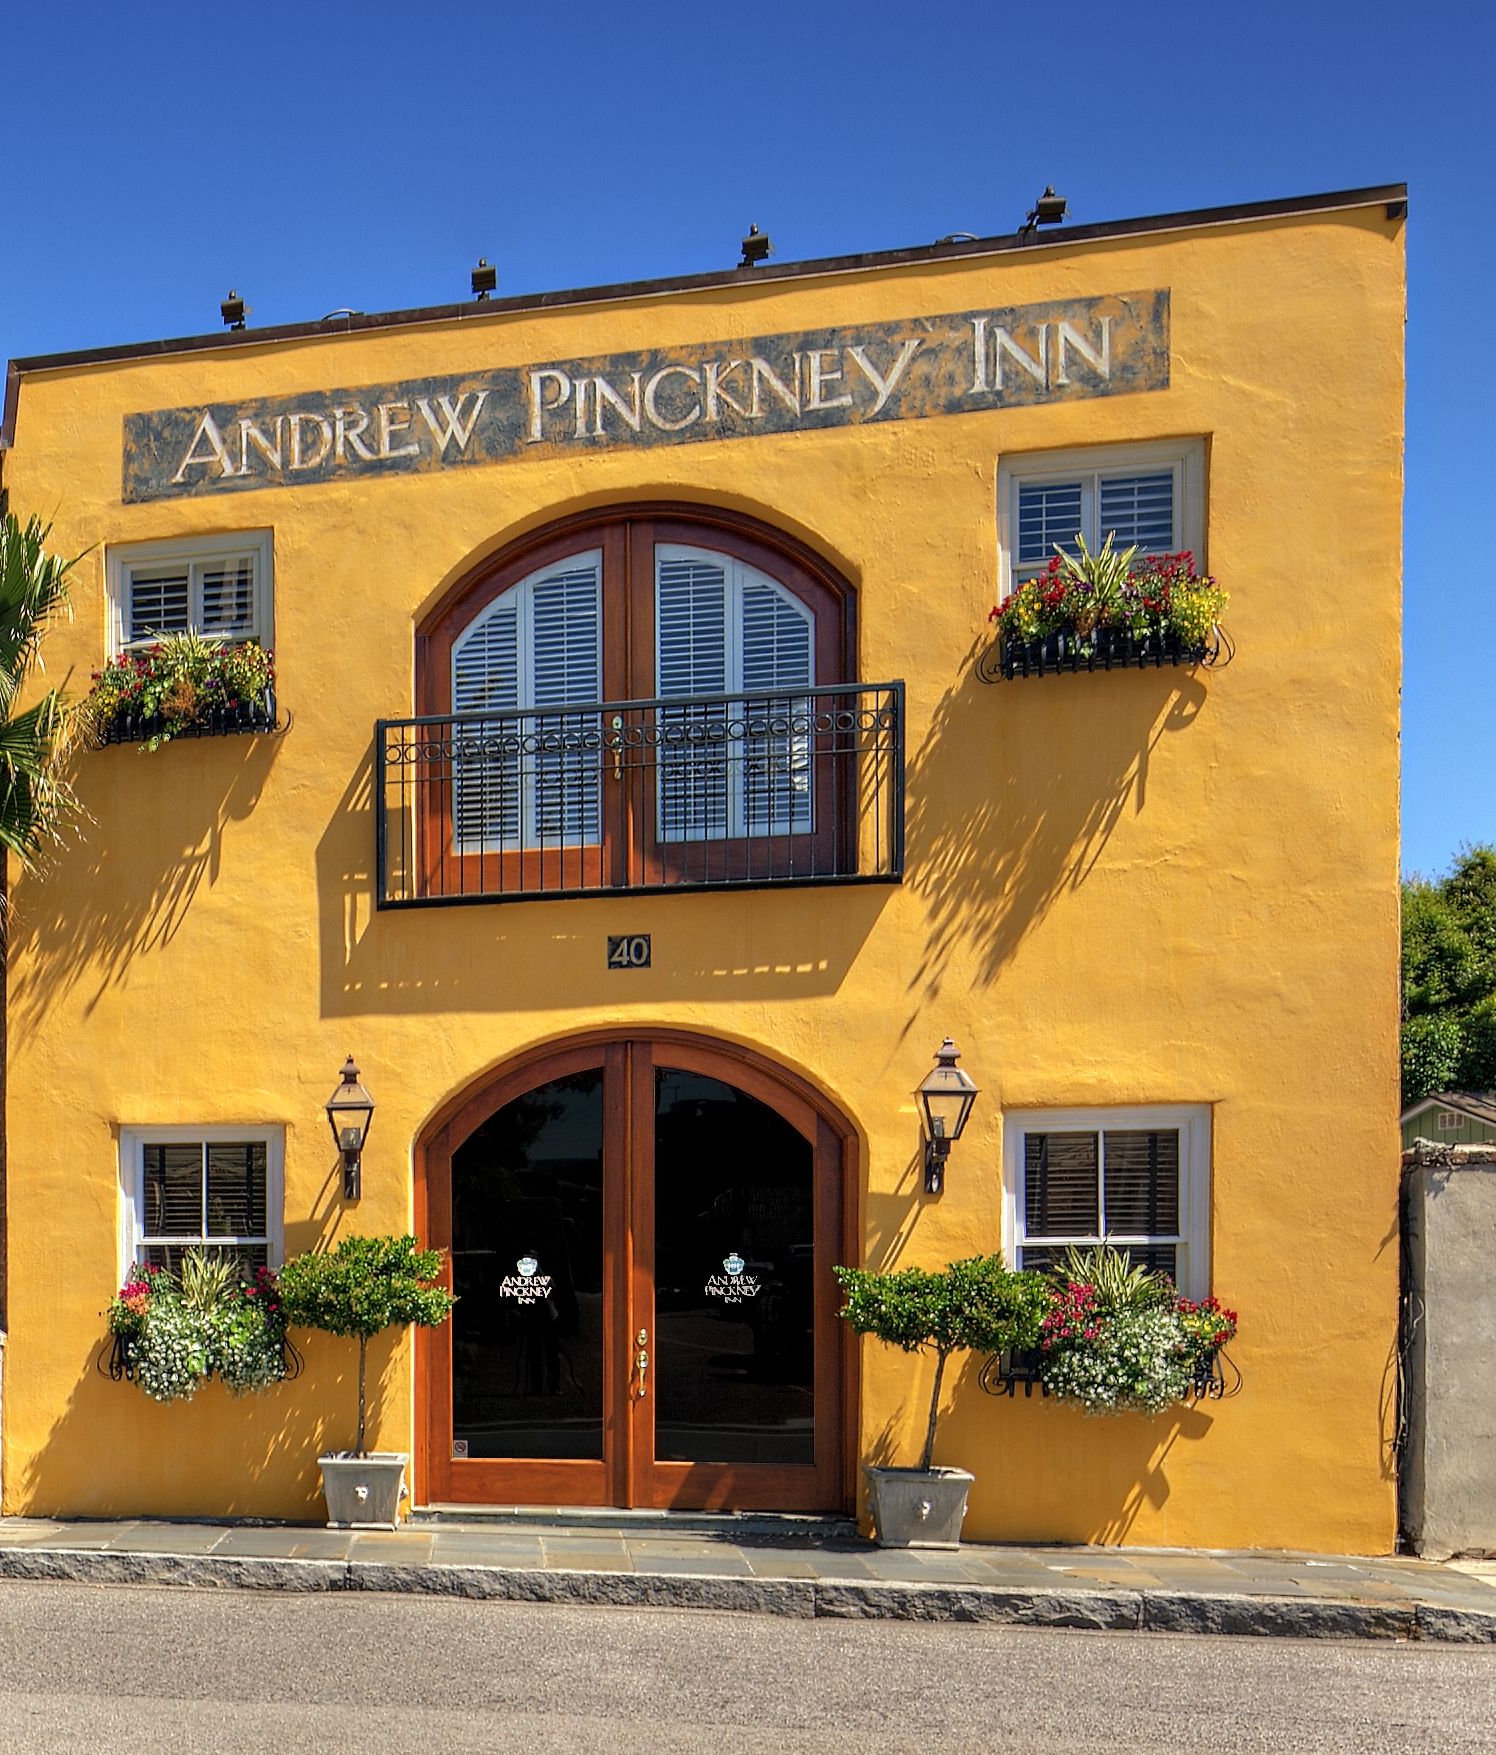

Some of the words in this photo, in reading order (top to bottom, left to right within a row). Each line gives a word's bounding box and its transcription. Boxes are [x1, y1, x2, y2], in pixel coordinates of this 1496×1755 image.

[171, 389, 490, 484] ANDREW
[526, 338, 923, 444] PINCKNEY
[968, 315, 1113, 394] INN
[610, 937, 648, 966] 40
[502, 1276, 551, 1286] ANDREW
[707, 1274, 758, 1285] ANDREW
[499, 1285, 553, 1298] PINCKNEY
[705, 1285, 762, 1297] PINCKNEY
[518, 1296, 536, 1304] INN
